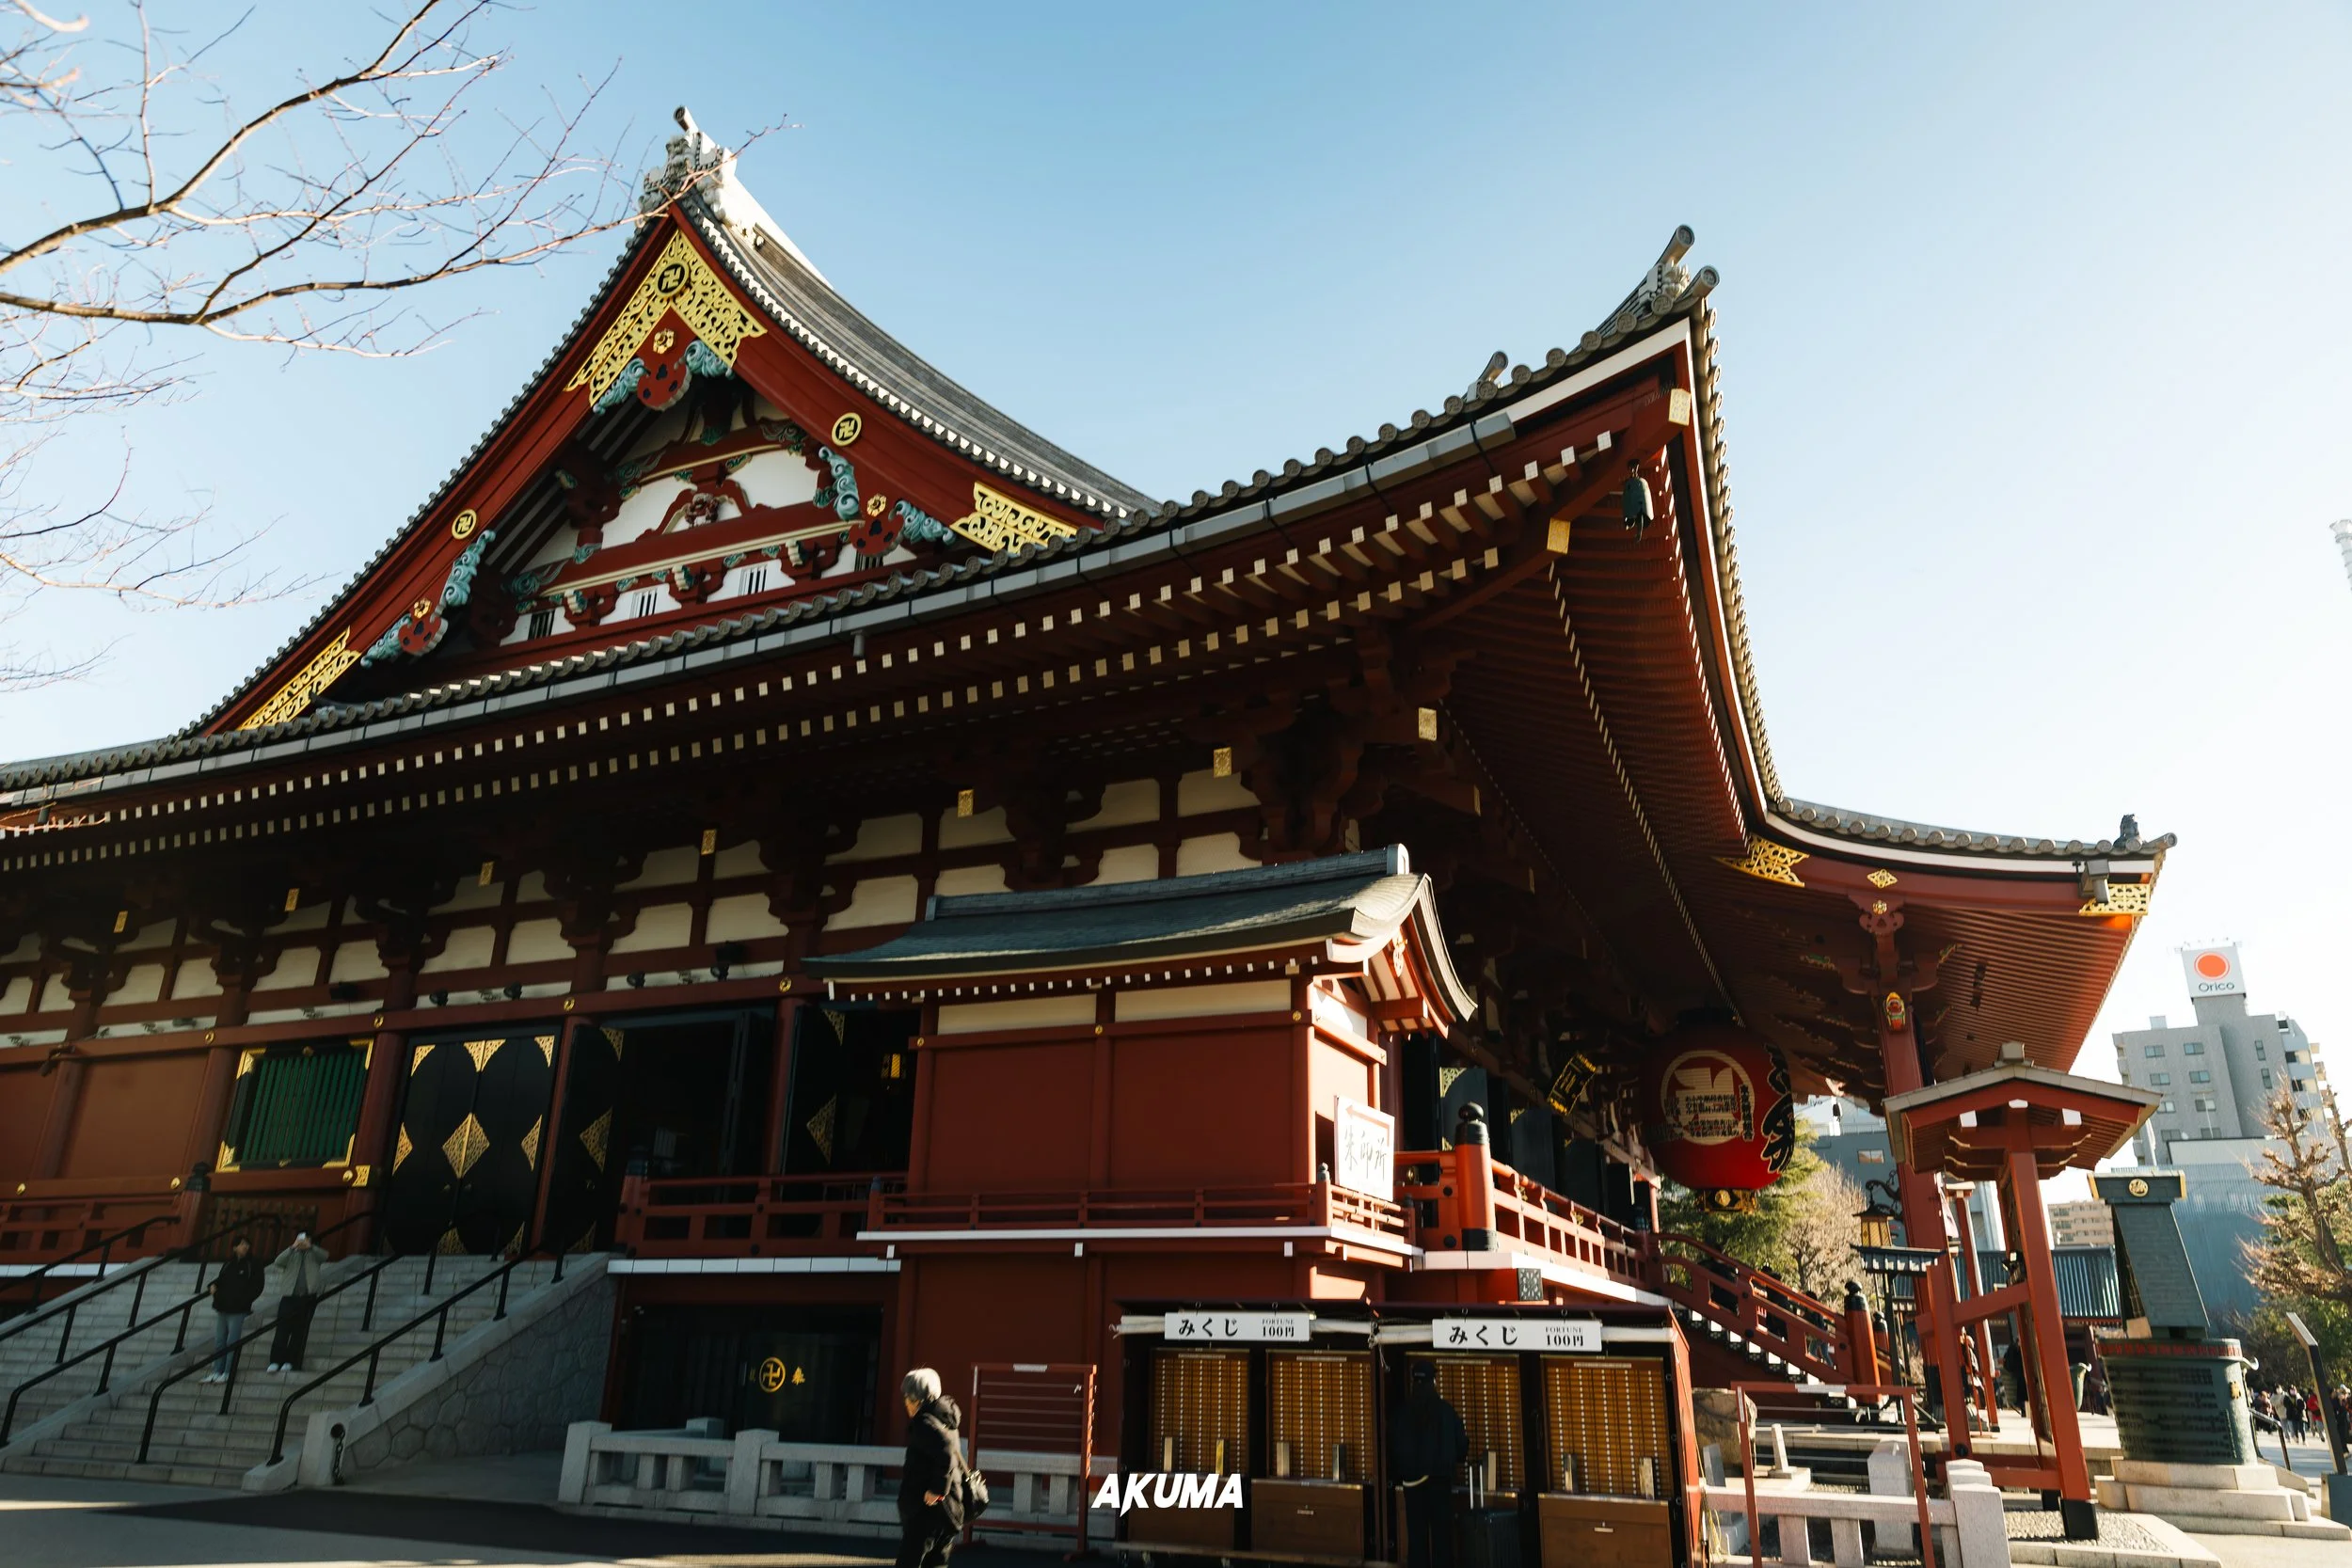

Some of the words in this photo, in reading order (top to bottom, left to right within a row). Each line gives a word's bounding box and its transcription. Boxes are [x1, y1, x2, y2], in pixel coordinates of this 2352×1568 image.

[2198, 982, 2234, 992] Orico
[1178, 1318, 1239, 1338] みくじ
[1262, 1325, 1295, 1338] 100円
[1449, 1324, 1518, 1346] みくじ
[1546, 1334, 1584, 1347] 100円
